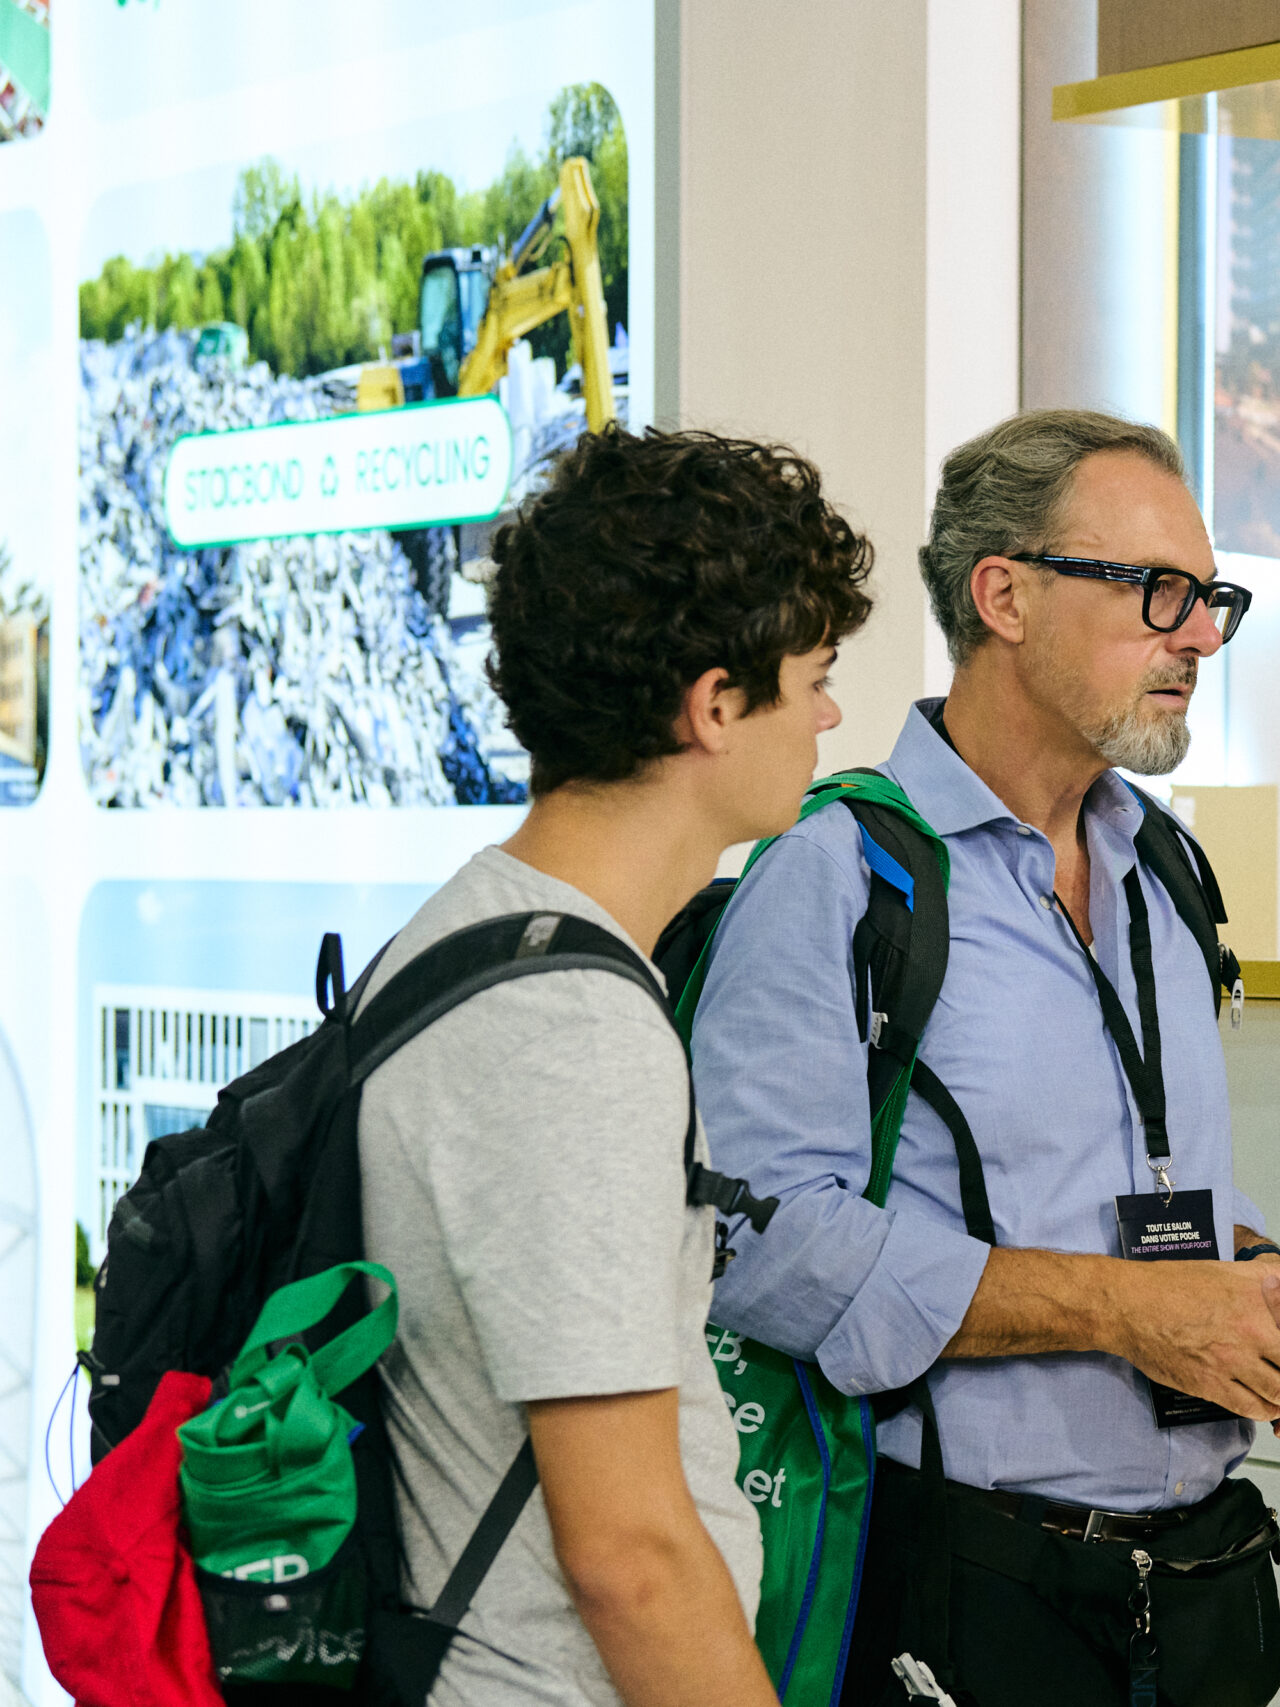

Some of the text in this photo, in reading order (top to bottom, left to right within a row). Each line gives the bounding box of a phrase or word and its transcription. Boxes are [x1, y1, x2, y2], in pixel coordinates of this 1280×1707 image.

[356, 434, 490, 493] RECYCLING
[1146, 1222, 1192, 1232] TOUT LE SALON
[1141, 1232, 1200, 1244] DANS VOTRE POCHE
[1142, 1245, 1159, 1253] ENTIRE
[1160, 1244, 1174, 1252] SHOW
[1180, 1242, 1193, 1250] YOUR
